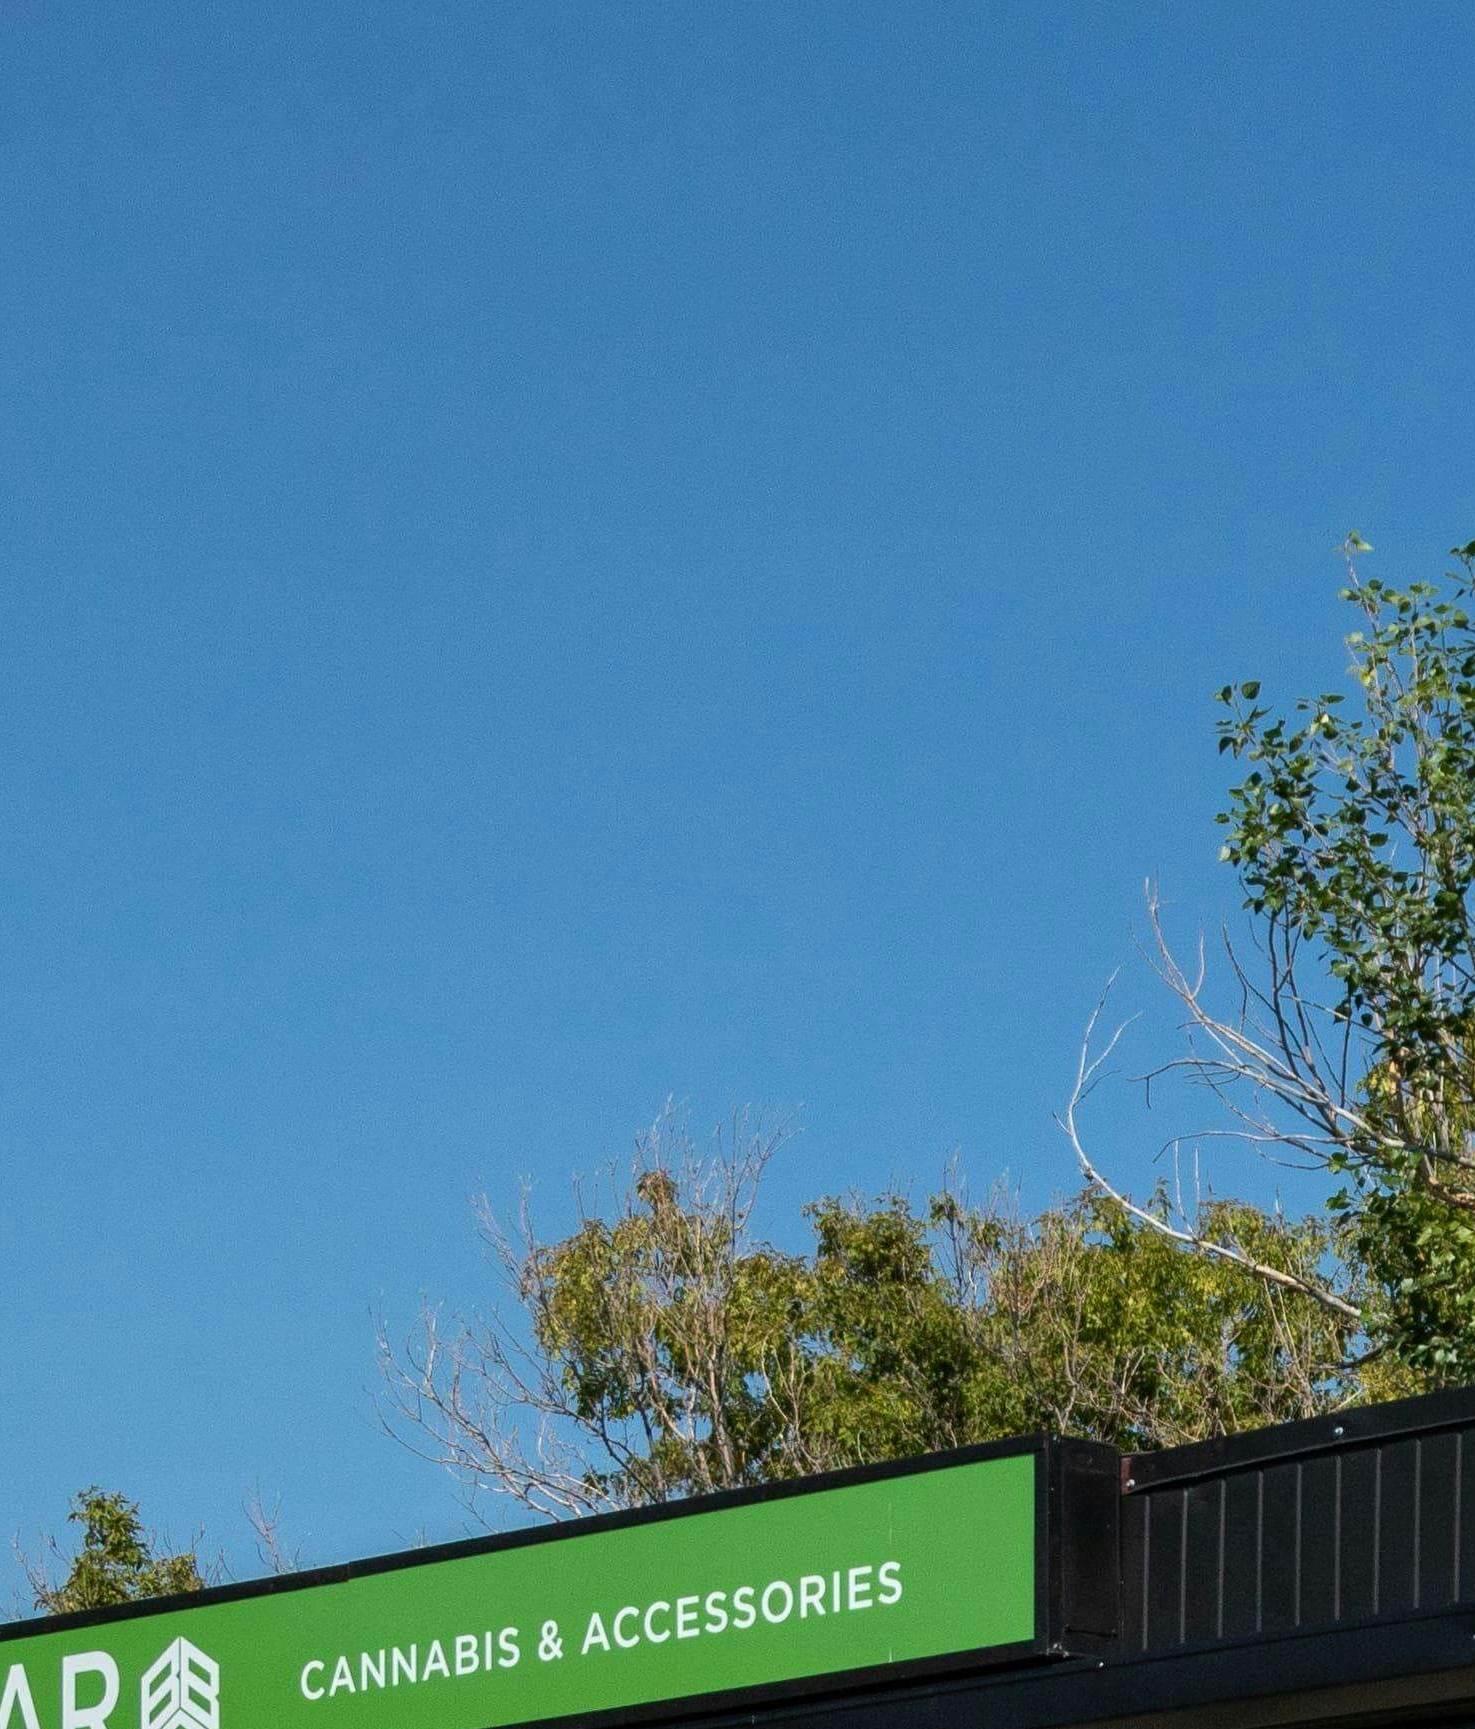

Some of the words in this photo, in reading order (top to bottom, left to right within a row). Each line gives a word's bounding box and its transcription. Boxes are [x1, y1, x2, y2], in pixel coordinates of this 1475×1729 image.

[300, 1627, 521, 1701] CANNABIS
[537, 1619, 564, 1661] &
[581, 1561, 904, 1654] ACCESSORIES
